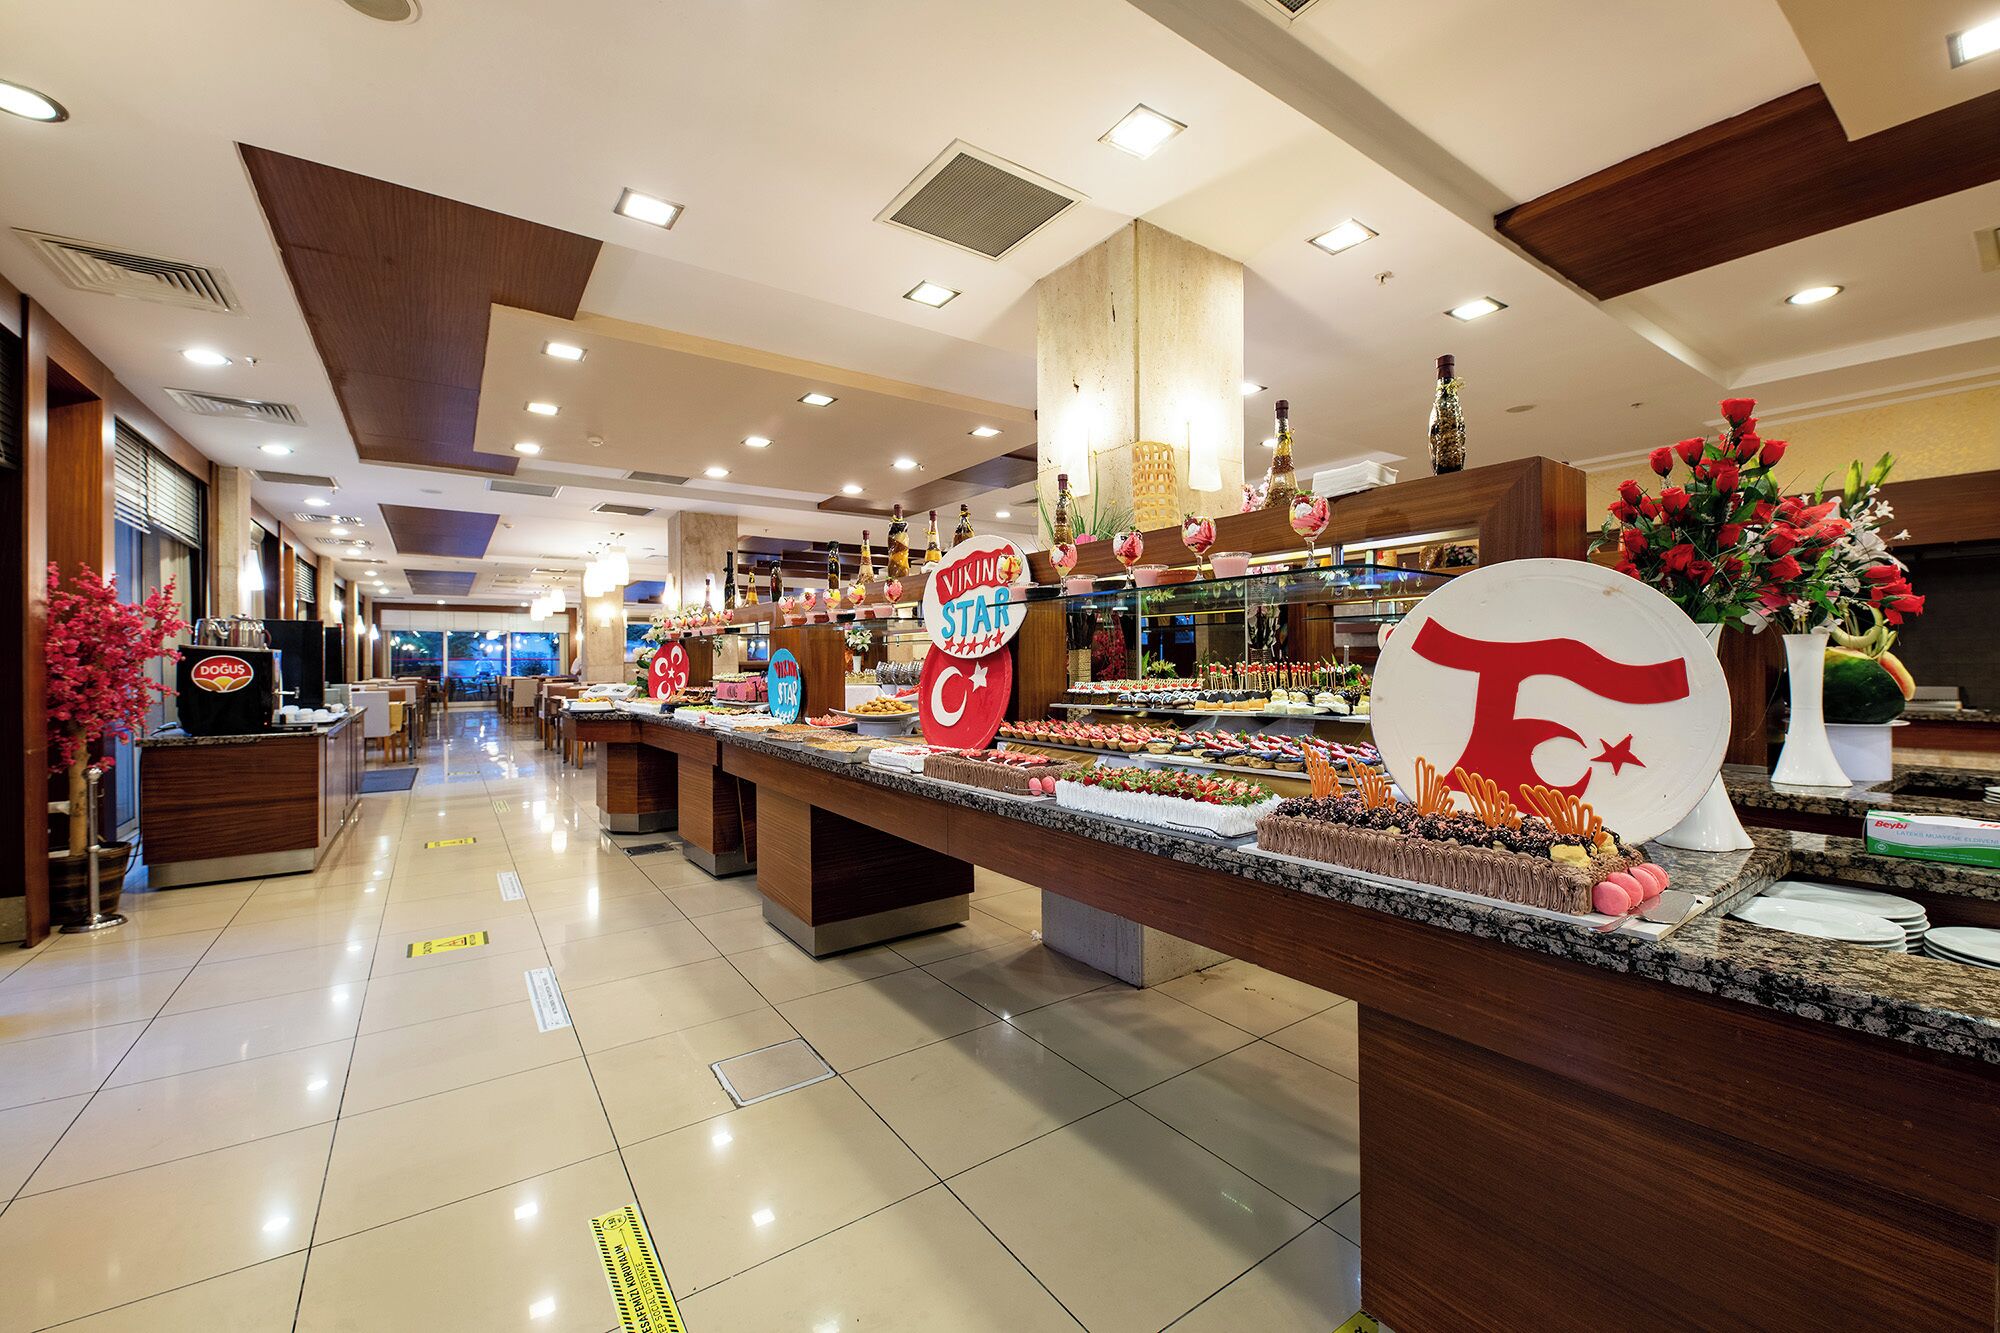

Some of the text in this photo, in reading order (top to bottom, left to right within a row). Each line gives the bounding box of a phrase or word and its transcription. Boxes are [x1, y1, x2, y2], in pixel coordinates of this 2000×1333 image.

[941, 587, 1010, 639] STAR
[200, 663, 246, 675] DOĞUŞ
[778, 681, 798, 706] STAR
[1874, 820, 1909, 829] Beybi
[614, 1243, 652, 1333] ESAFEMİZİ KORUYALIM
[635, 1262, 653, 1295] DISTANCE
[649, 1295, 663, 1321] SOCIAL
